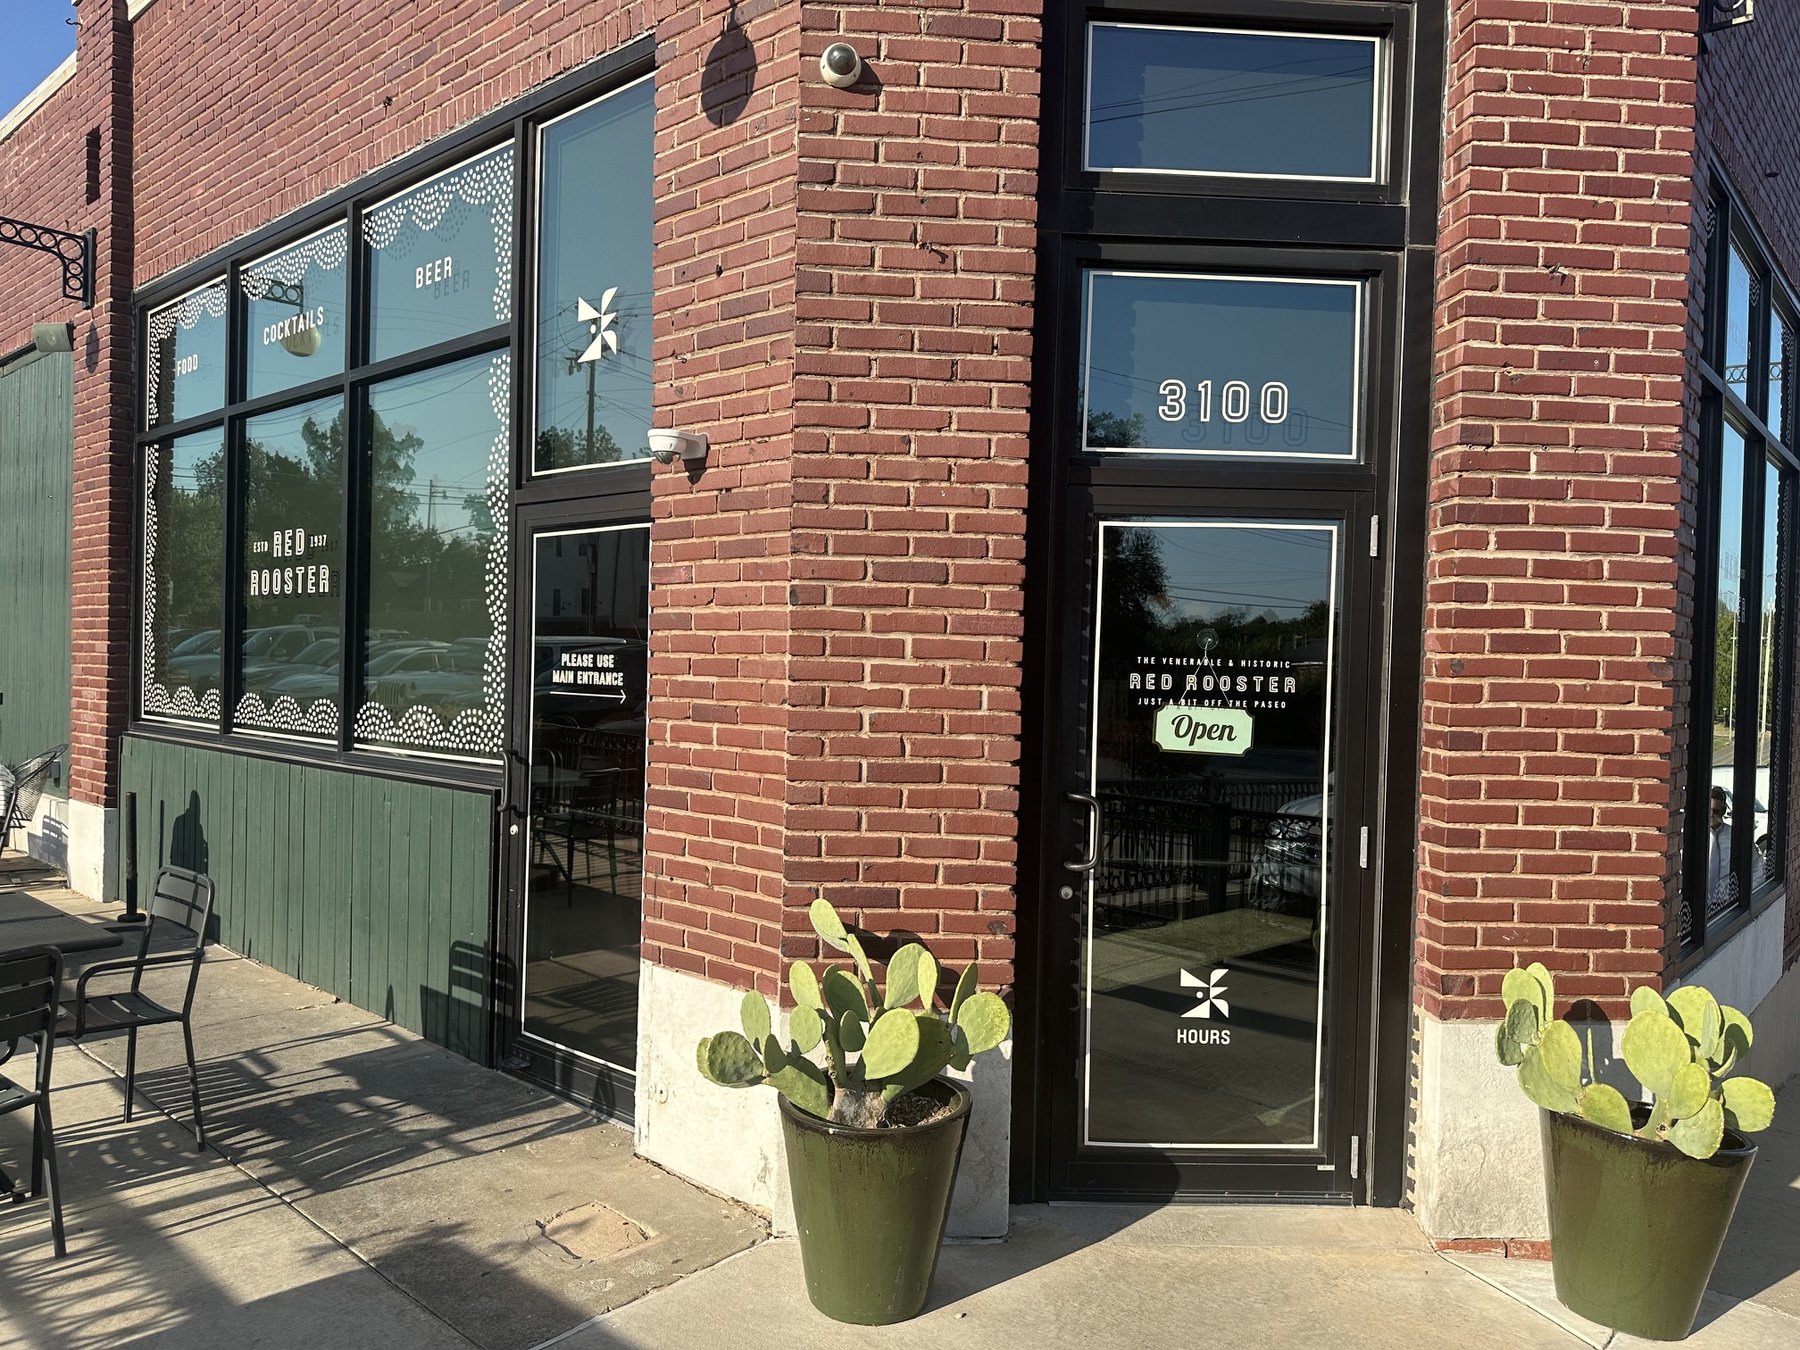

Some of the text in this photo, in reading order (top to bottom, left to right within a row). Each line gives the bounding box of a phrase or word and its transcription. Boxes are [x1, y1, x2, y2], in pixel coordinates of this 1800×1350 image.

[415, 255, 453, 290] BEER
[263, 305, 325, 346] COCKTAILS
[176, 353, 198, 377] FOOD
[1158, 378, 1289, 424] 3100
[253, 528, 327, 557] ESTD RED 1937
[250, 564, 329, 596] ROOSTER
[561, 653, 615, 669] PLEASE USE
[1137, 656, 1291, 669] THE VENERABLE & HISTORIC
[552, 669, 624, 686] MAIN ENTRANCE
[1129, 673, 1296, 693] RED ROOSTER
[1138, 697, 1287, 709] JUST A BIT OFF THE PASEO
[1171, 714, 1238, 747] Open
[1176, 1028, 1231, 1045] HOURS
